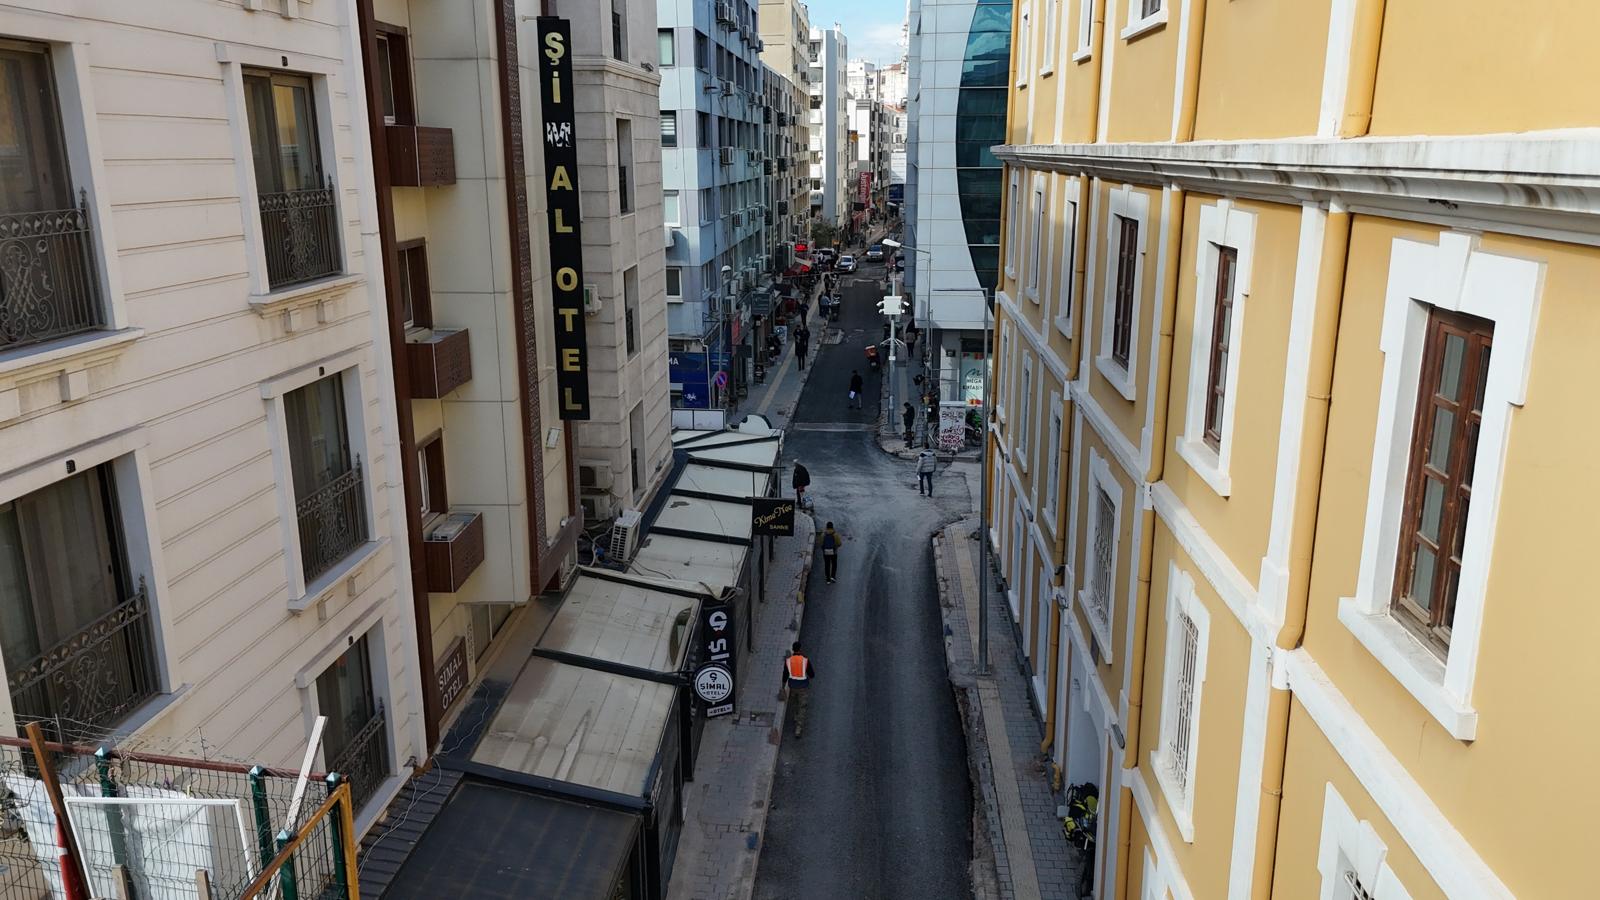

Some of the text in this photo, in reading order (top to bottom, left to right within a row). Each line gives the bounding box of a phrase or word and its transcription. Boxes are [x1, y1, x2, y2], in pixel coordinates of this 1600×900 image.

[556, 267, 582, 410] OTEL
[442, 675, 463, 710] OTEL
[715, 706, 726, 714] OTEL
